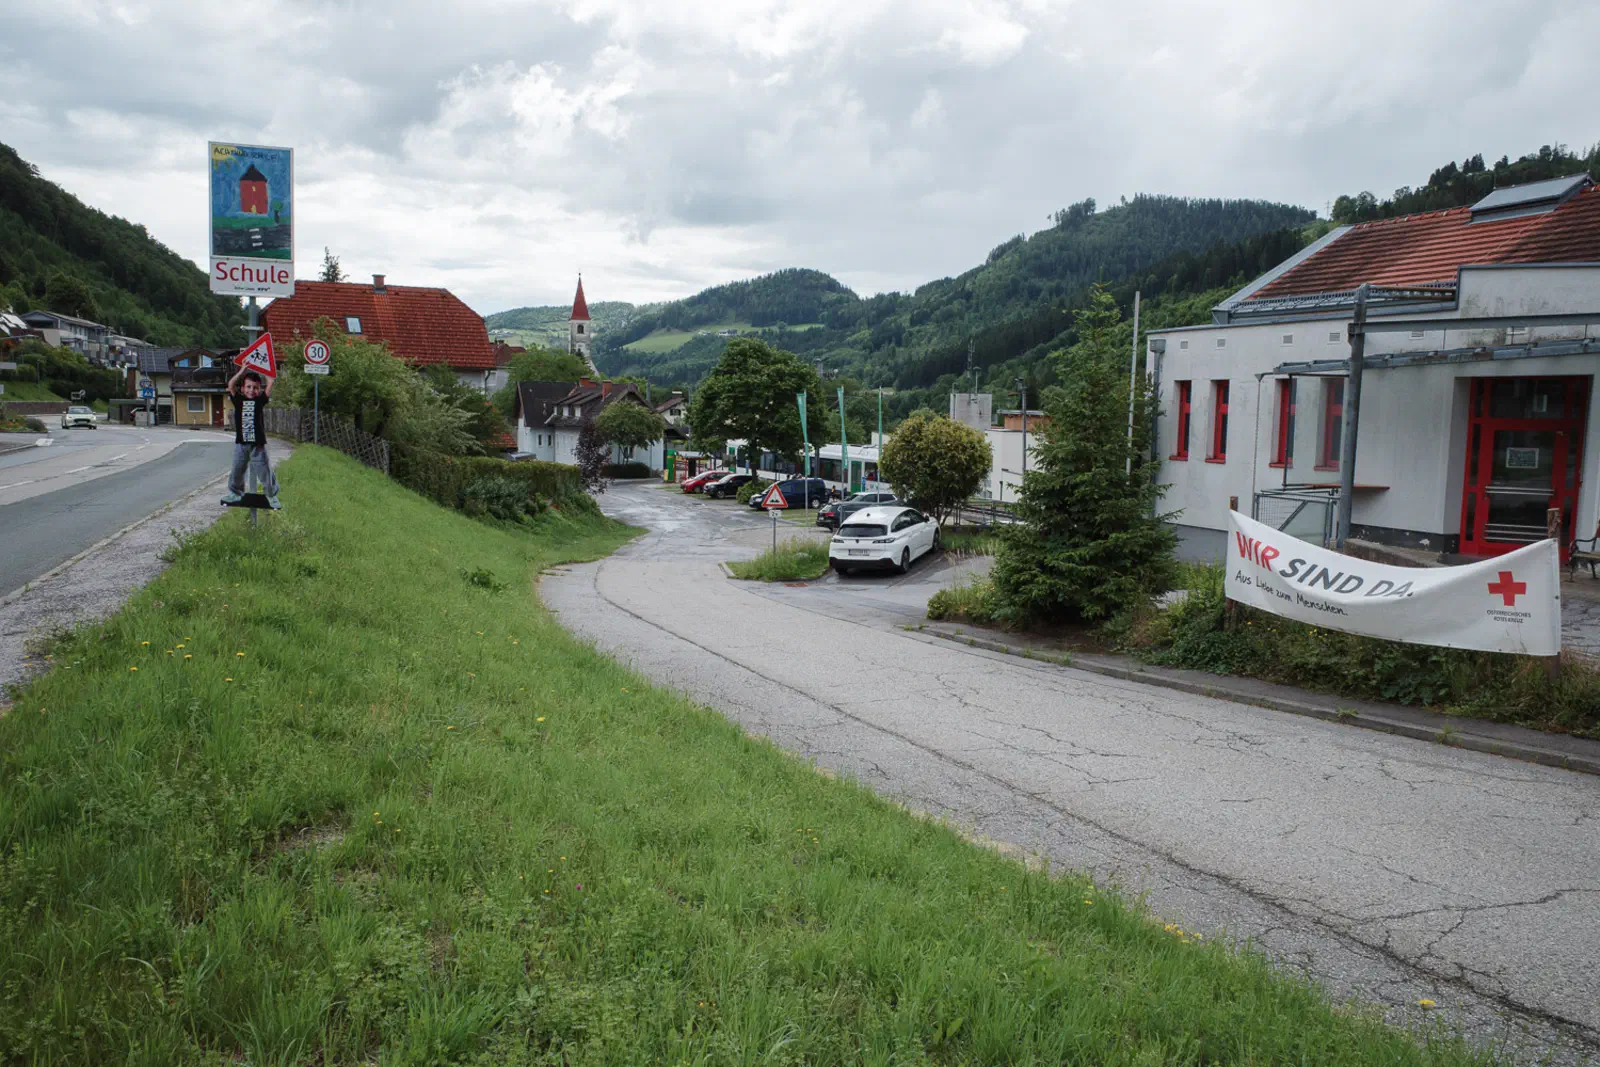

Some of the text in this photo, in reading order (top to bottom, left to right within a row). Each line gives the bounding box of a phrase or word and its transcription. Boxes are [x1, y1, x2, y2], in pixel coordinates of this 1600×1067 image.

[215, 261, 289, 285] Schule
[310, 346, 324, 359] 30
[1236, 531, 1414, 597] WIR SIND DA.
[1235, 570, 1348, 616] Aus Liebe zum Menschen.
